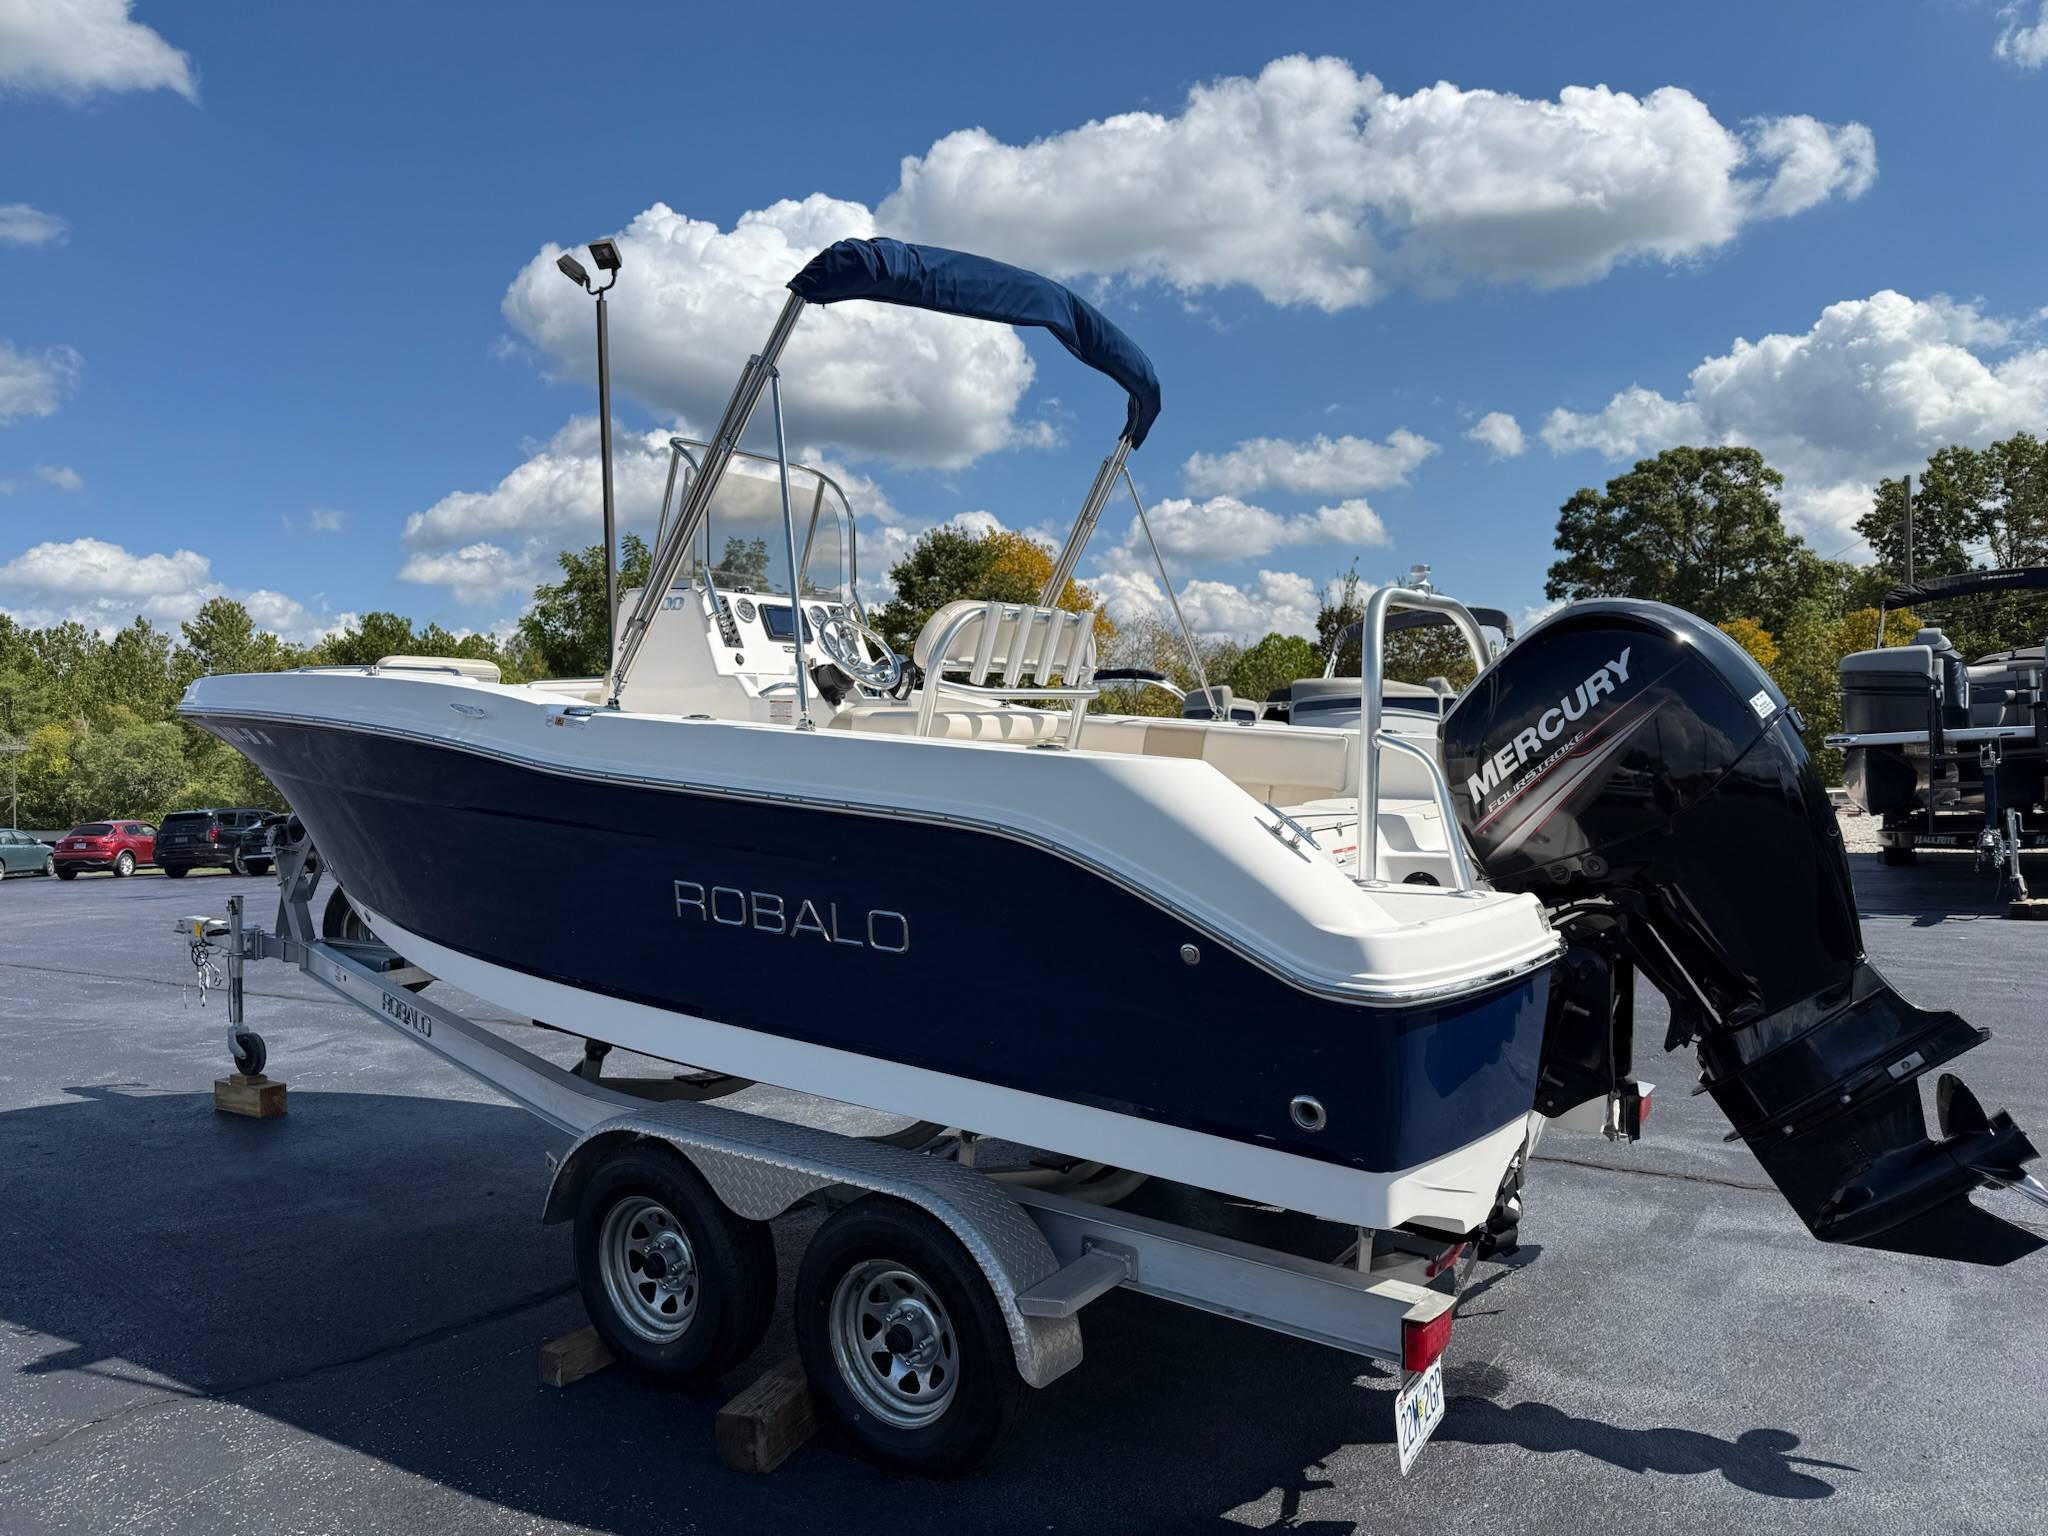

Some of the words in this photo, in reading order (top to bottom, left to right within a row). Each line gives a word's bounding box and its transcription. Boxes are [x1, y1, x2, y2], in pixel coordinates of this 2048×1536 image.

[1467, 646, 1631, 805] MERCURY
[1487, 730, 1587, 814] FOURSTROKE
[673, 879, 911, 954] ROBALO
[382, 991, 432, 1038] ROBALO
